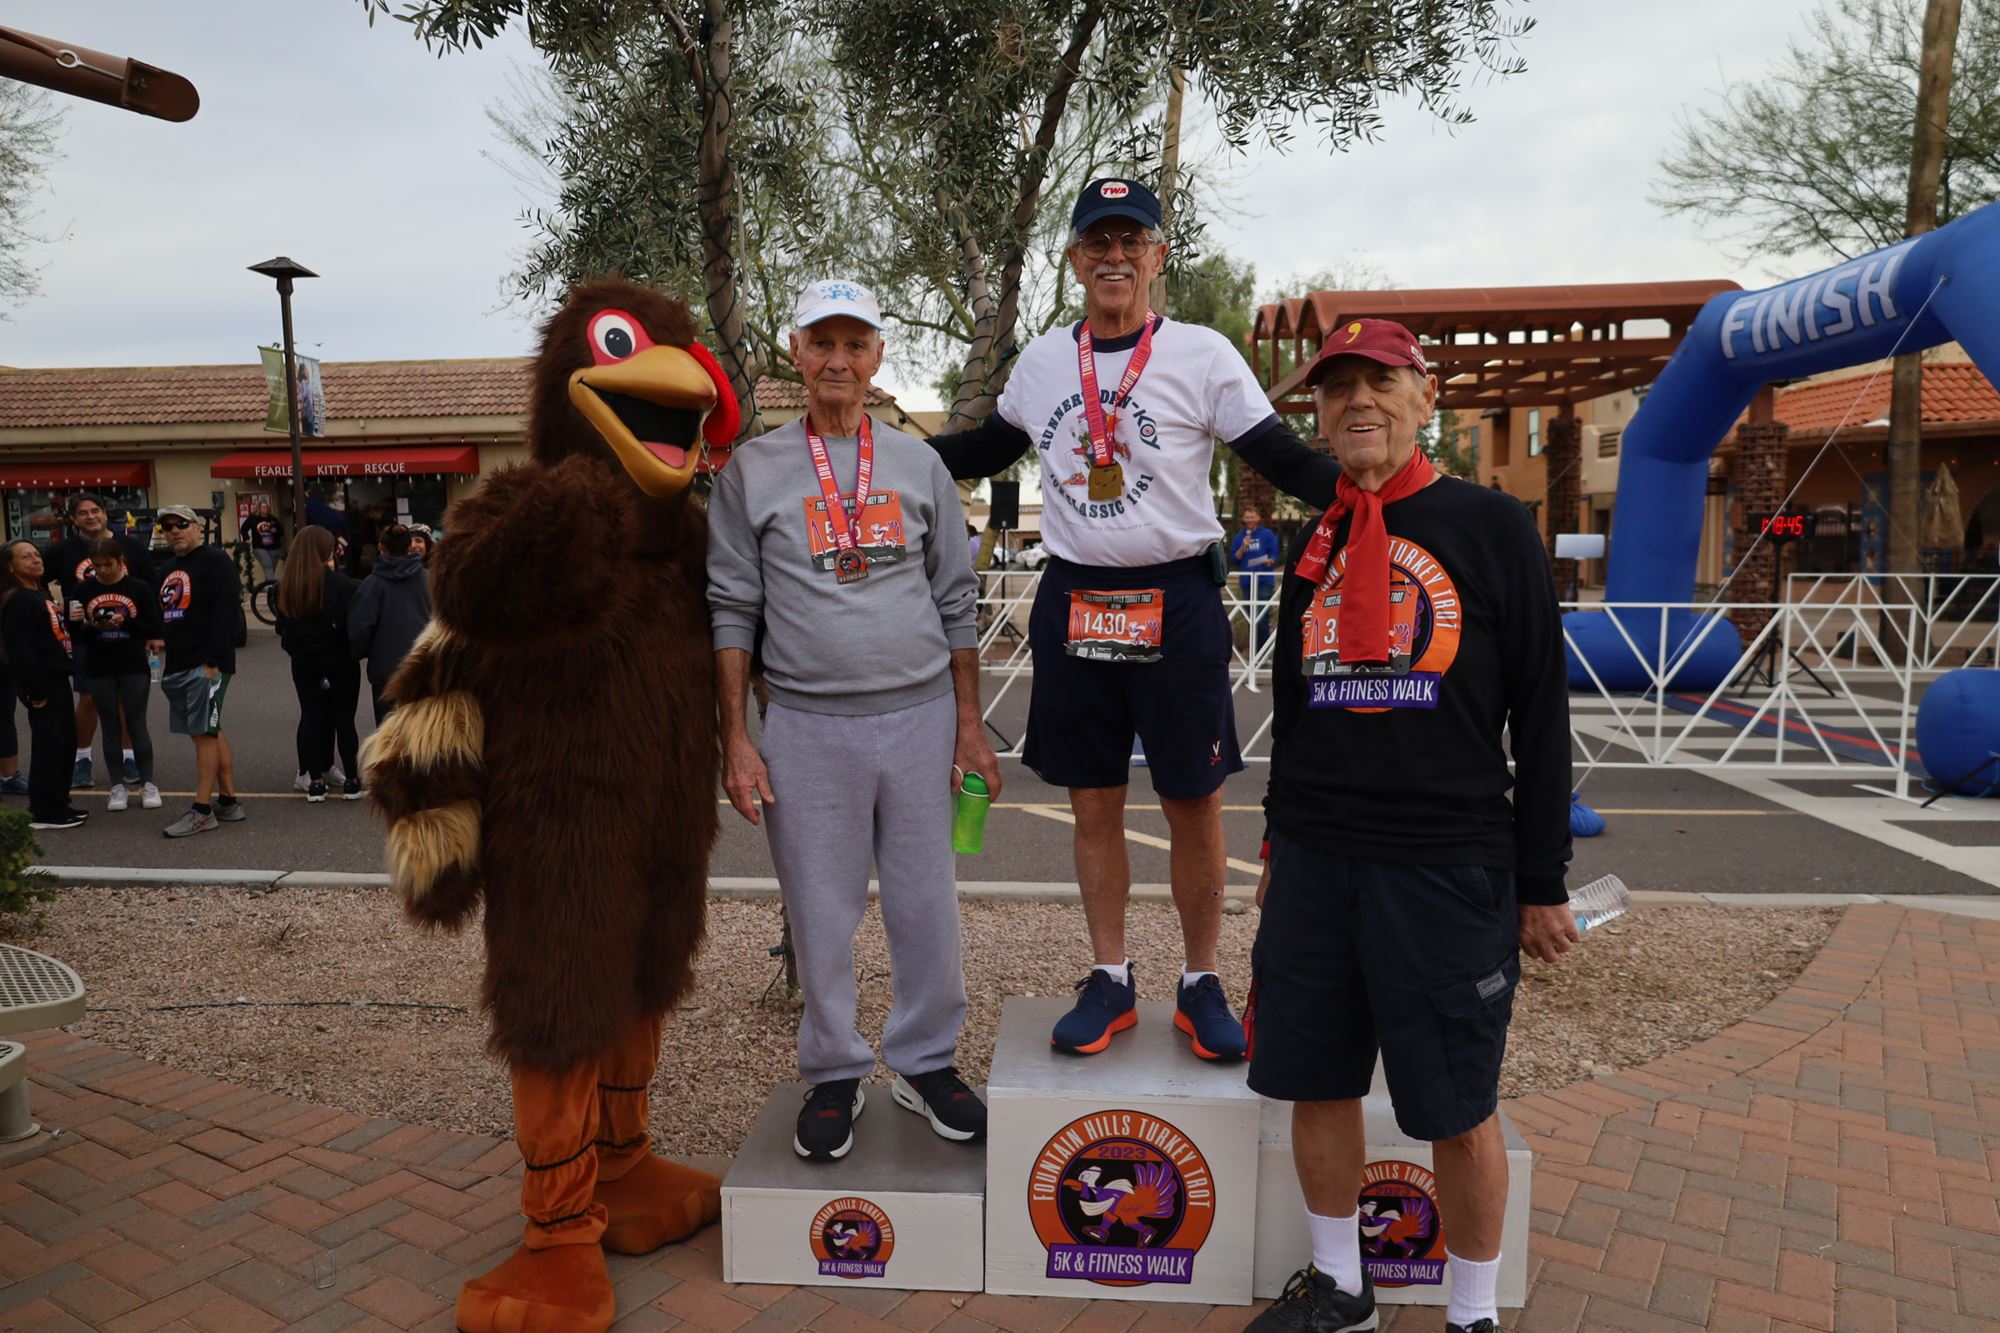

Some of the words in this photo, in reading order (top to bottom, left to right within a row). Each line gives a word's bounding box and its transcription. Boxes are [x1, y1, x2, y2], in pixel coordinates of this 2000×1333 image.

[1102, 187, 1127, 195] TWA
[1721, 255, 1900, 359] FINISH
[1079, 329, 1091, 348] TROT
[1079, 348, 1094, 377] TURKEY
[1040, 391, 1085, 451] RUNNER
[809, 435, 827, 460] TURKEY
[1093, 438, 1107, 460] 2023
[255, 466, 294, 476] FEARLE
[317, 464, 349, 475] KITTY
[364, 463, 405, 473] RESCUE
[816, 462, 832, 480] TROT
[860, 457, 871, 475] TROT
[857, 474, 870, 503] TURKEY
[1126, 473, 1154, 506] 1981
[1388, 540, 1445, 586] TURKEY
[1432, 588, 1457, 630] TROT
[1083, 611, 1127, 635] 1430
[1324, 618, 1340, 644] 3
[1313, 681, 1326, 702] 5K
[1327, 681, 1337, 701] &
[1339, 679, 1389, 701] FITNESS
[1392, 679, 1434, 701] WALK
[1033, 1128, 1085, 1201] FOUNTAIN
[1083, 1115, 1131, 1141] HILLS
[1138, 1117, 1197, 1166] TURKEY
[1184, 1167, 1211, 1208] TROT
[1100, 1147, 1147, 1159] 2023
[1364, 1164, 1399, 1184] HILLS
[834, 1199, 857, 1212] HILLS
[858, 1201, 885, 1224] TURKEY
[880, 1223, 894, 1242] TROT
[821, 1261, 831, 1272] 5K
[830, 1262, 838, 1272] &
[837, 1262, 863, 1273] FITNESS
[863, 1264, 883, 1274] WALK
[1053, 1251, 1073, 1272] 5K
[1074, 1253, 1085, 1272] &
[1088, 1252, 1143, 1274] FITNESS
[1147, 1255, 1188, 1276] WALK
[1368, 1263, 1407, 1279] FITNESS
[1409, 1264, 1440, 1280] WALK
